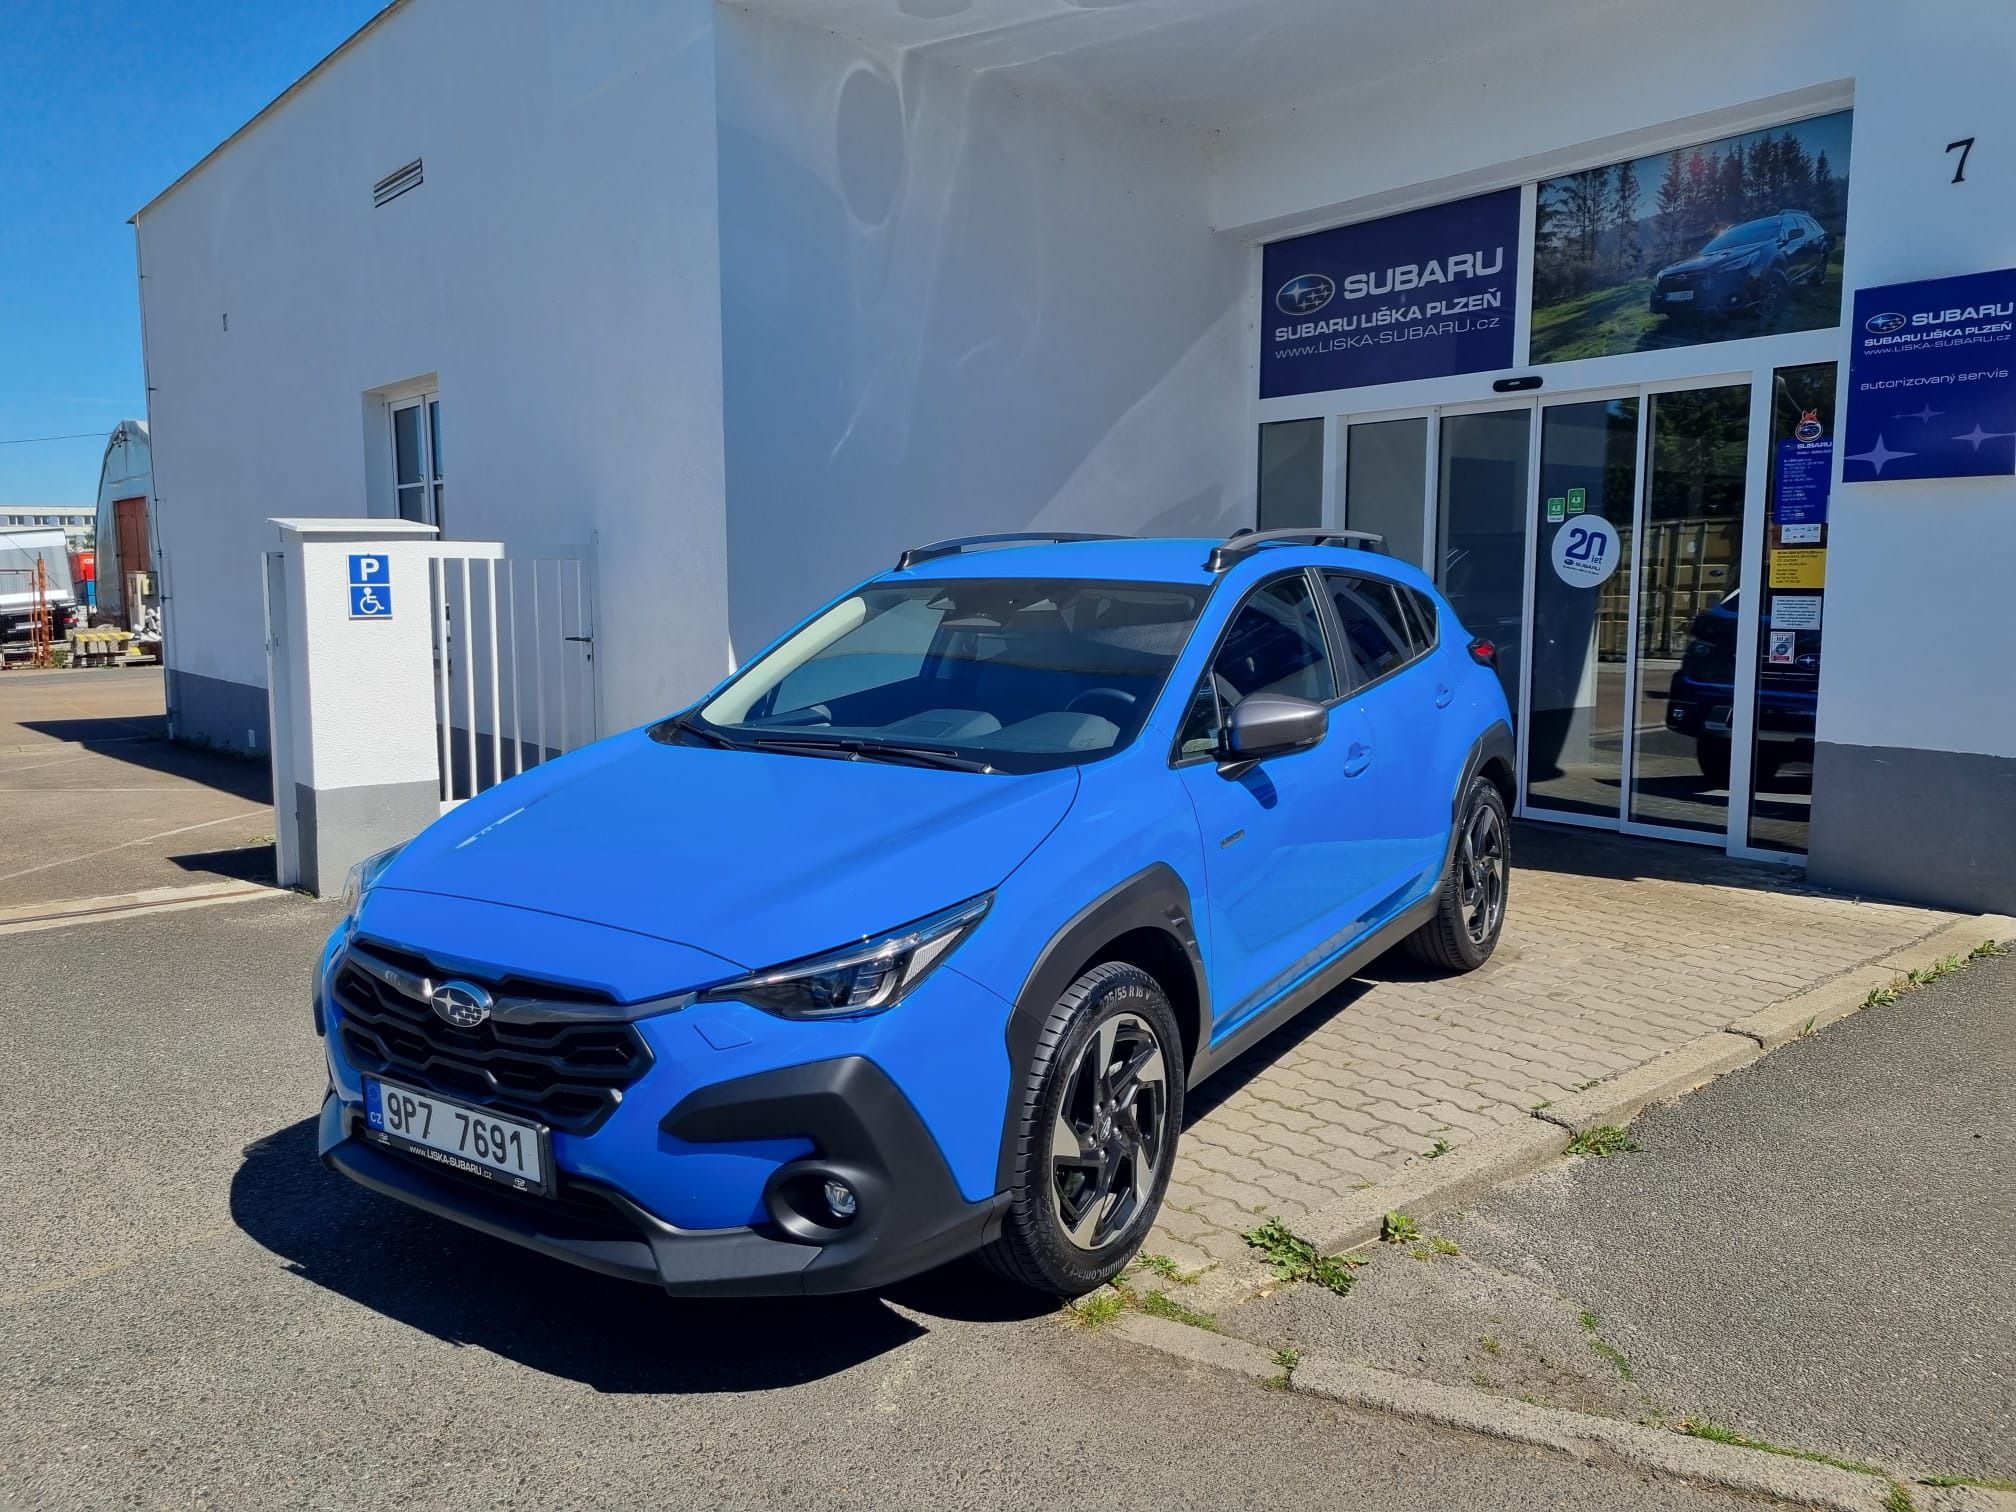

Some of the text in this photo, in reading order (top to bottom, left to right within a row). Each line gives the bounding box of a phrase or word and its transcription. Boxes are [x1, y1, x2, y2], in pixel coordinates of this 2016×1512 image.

[1945, 137, 1975, 184] 7
[1343, 247, 1504, 300] SUBARU
[1275, 287, 1501, 342] SUBARU LIŠKA PLZEŇ
[1912, 302, 2014, 326] SUBARU
[1275, 316, 1500, 359] www.LISKA-SUBARU.cz
[1864, 320, 2013, 347] SUBARU LIŠKA PLZEŇ
[1864, 334, 2012, 356] www.LISKA-SUBARU.cz
[1860, 367, 2009, 391] autorizovaný servis
[360, 558, 380, 582] P
[1591, 555, 1603, 565] let
[369, 1111, 383, 1125] CZ
[386, 1091, 524, 1172] 9P7 7691
[409, 1145, 493, 1180] www.LISKA-SUBARU.cz
